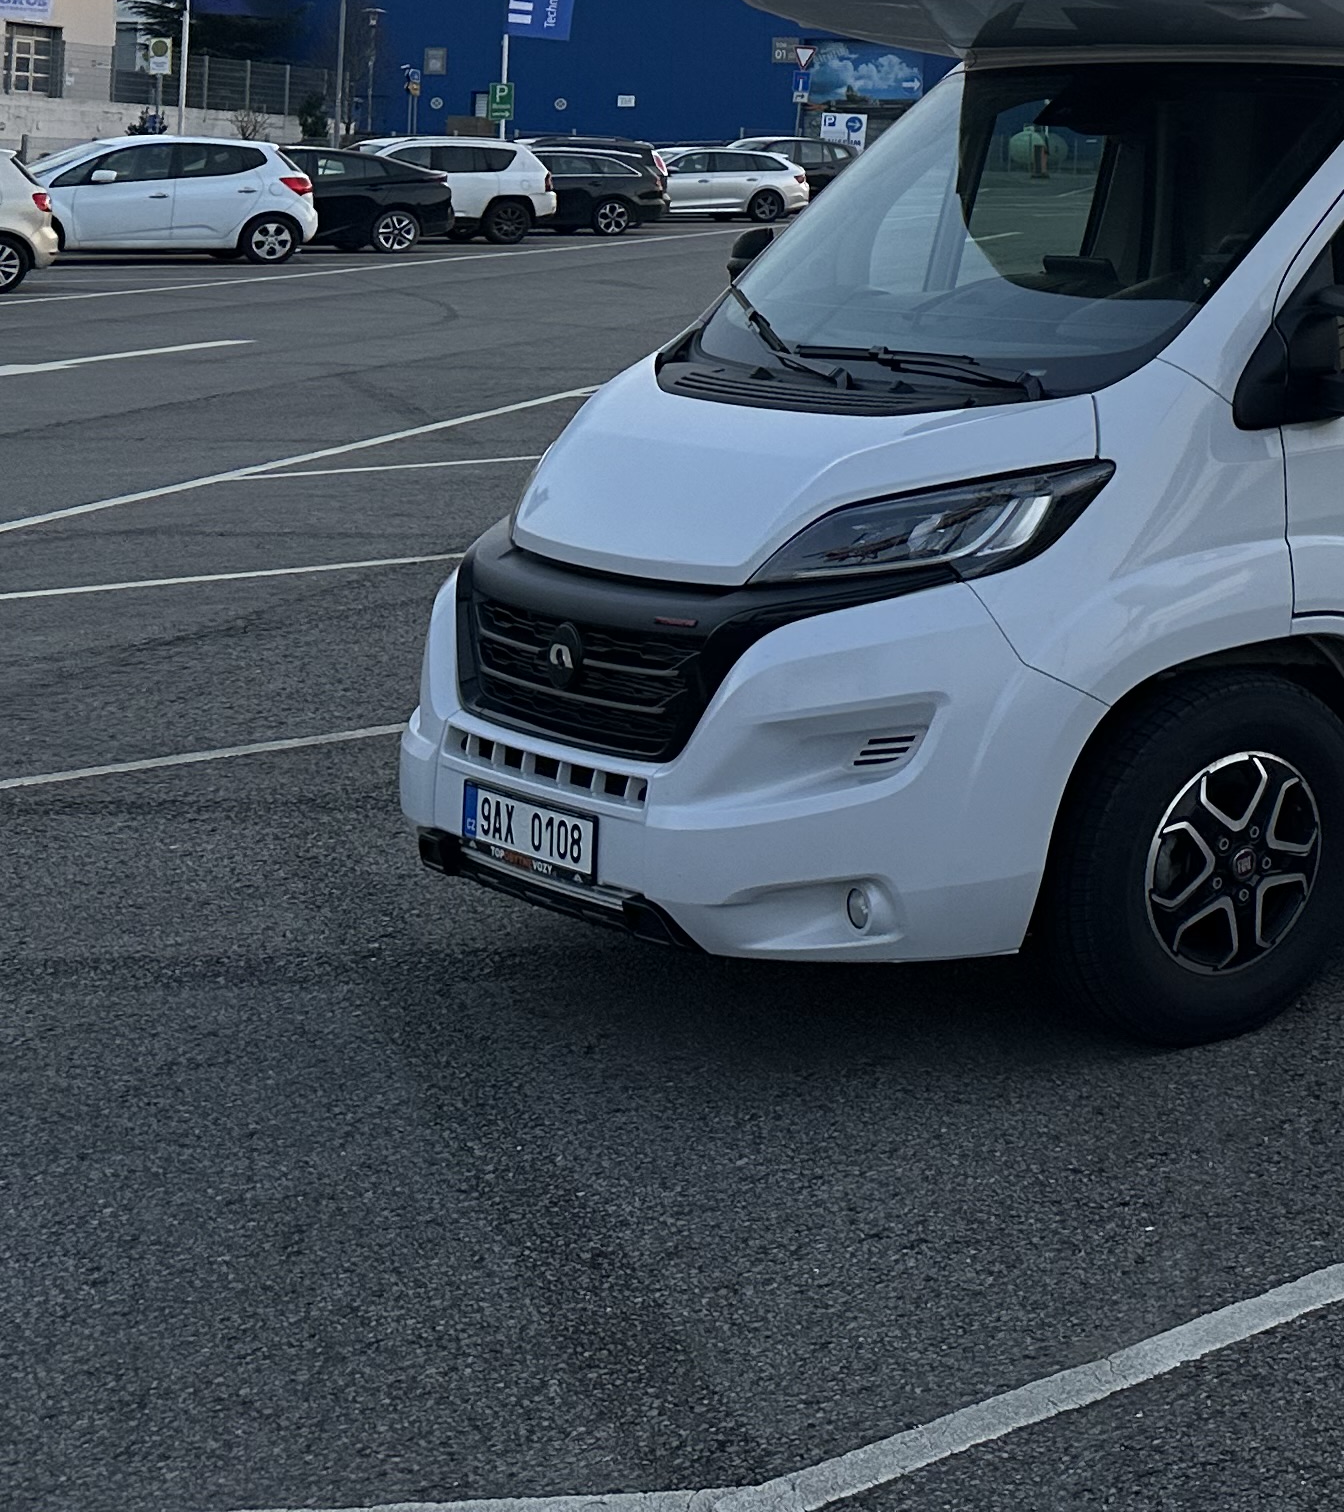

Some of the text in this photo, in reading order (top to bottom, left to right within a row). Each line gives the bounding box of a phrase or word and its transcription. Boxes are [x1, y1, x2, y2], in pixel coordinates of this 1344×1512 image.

[496, 85, 509, 103] P
[825, 115, 836, 126] P
[466, 817, 476, 831] CZ
[480, 796, 582, 864] 9AX 0108
